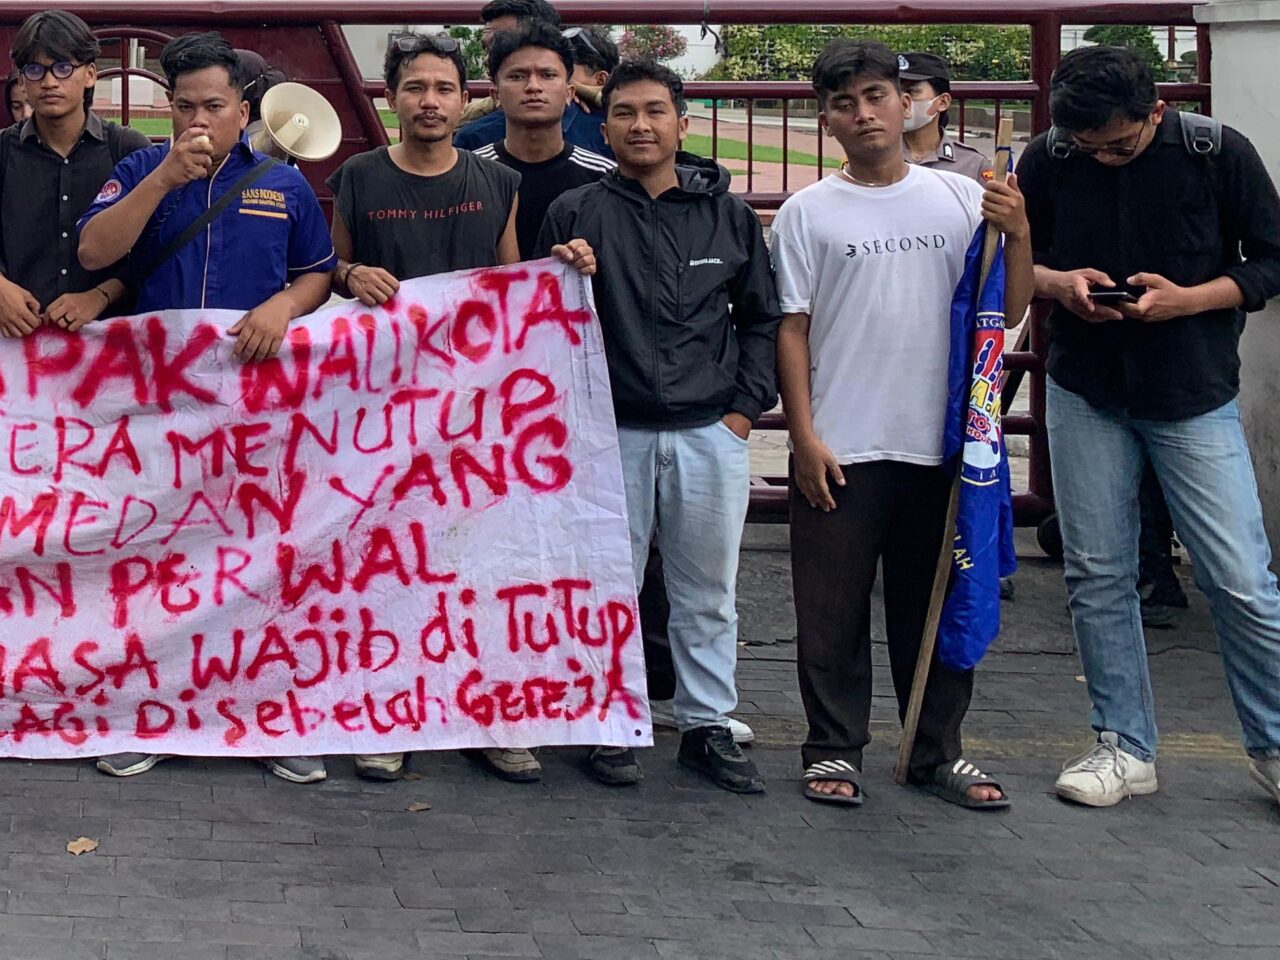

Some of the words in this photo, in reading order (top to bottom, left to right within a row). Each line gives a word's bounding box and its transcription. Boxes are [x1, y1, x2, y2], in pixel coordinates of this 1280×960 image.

[368, 208, 417, 220] TOMMY
[424, 201, 484, 219] HILFIGER
[166, 368, 557, 489] MENUTUP
[328, 415, 572, 531] YANG
[420, 589, 478, 663] di
